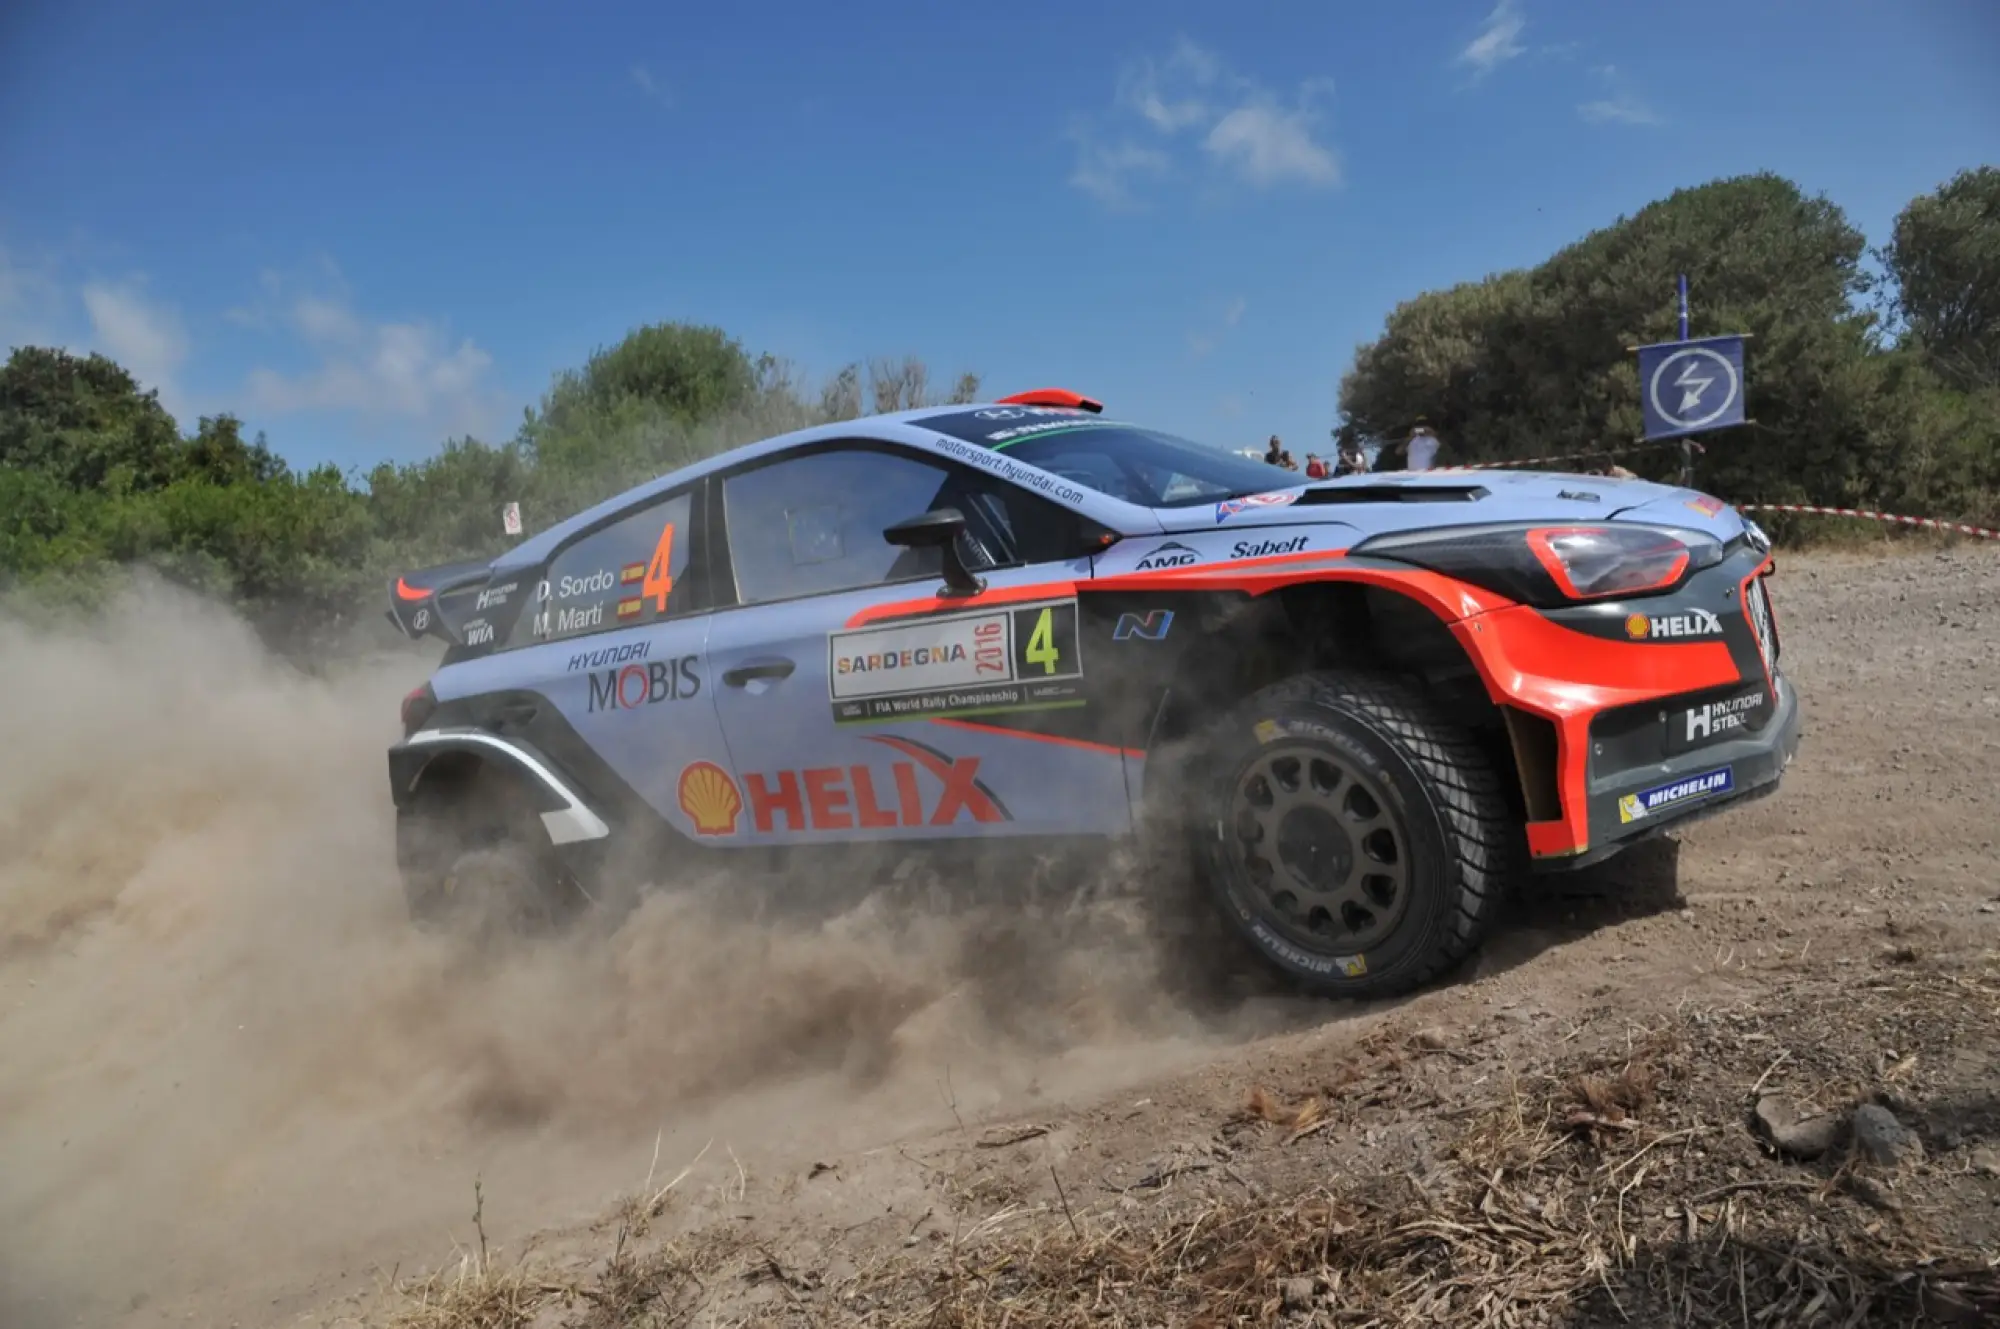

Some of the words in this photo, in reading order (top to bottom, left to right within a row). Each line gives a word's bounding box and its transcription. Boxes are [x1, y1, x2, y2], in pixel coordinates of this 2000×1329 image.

[935, 437, 1084, 504] motorsport.hyundai.com
[1135, 554, 1196, 571] AMG
[1230, 536, 1309, 559] Sabelt
[643, 522, 674, 613] 4
[537, 580, 553, 603] D.
[559, 568, 614, 599] Sordo
[468, 621, 494, 647] WIA
[557, 601, 605, 634] Martí
[1650, 608, 1723, 638] HELIX
[568, 640, 653, 672] HYUNDAI
[974, 621, 1004, 675] 2016
[1025, 607, 1059, 675] 4
[837, 643, 966, 675] SARDEGNA
[587, 654, 701, 714] MOBIS
[875, 701, 892, 715] FIA
[894, 699, 921, 713] World
[922, 697, 947, 711] Rally
[949, 690, 1019, 708] Championship
[744, 754, 1006, 834] HELIX
[1647, 771, 1727, 807] MICHELIN
